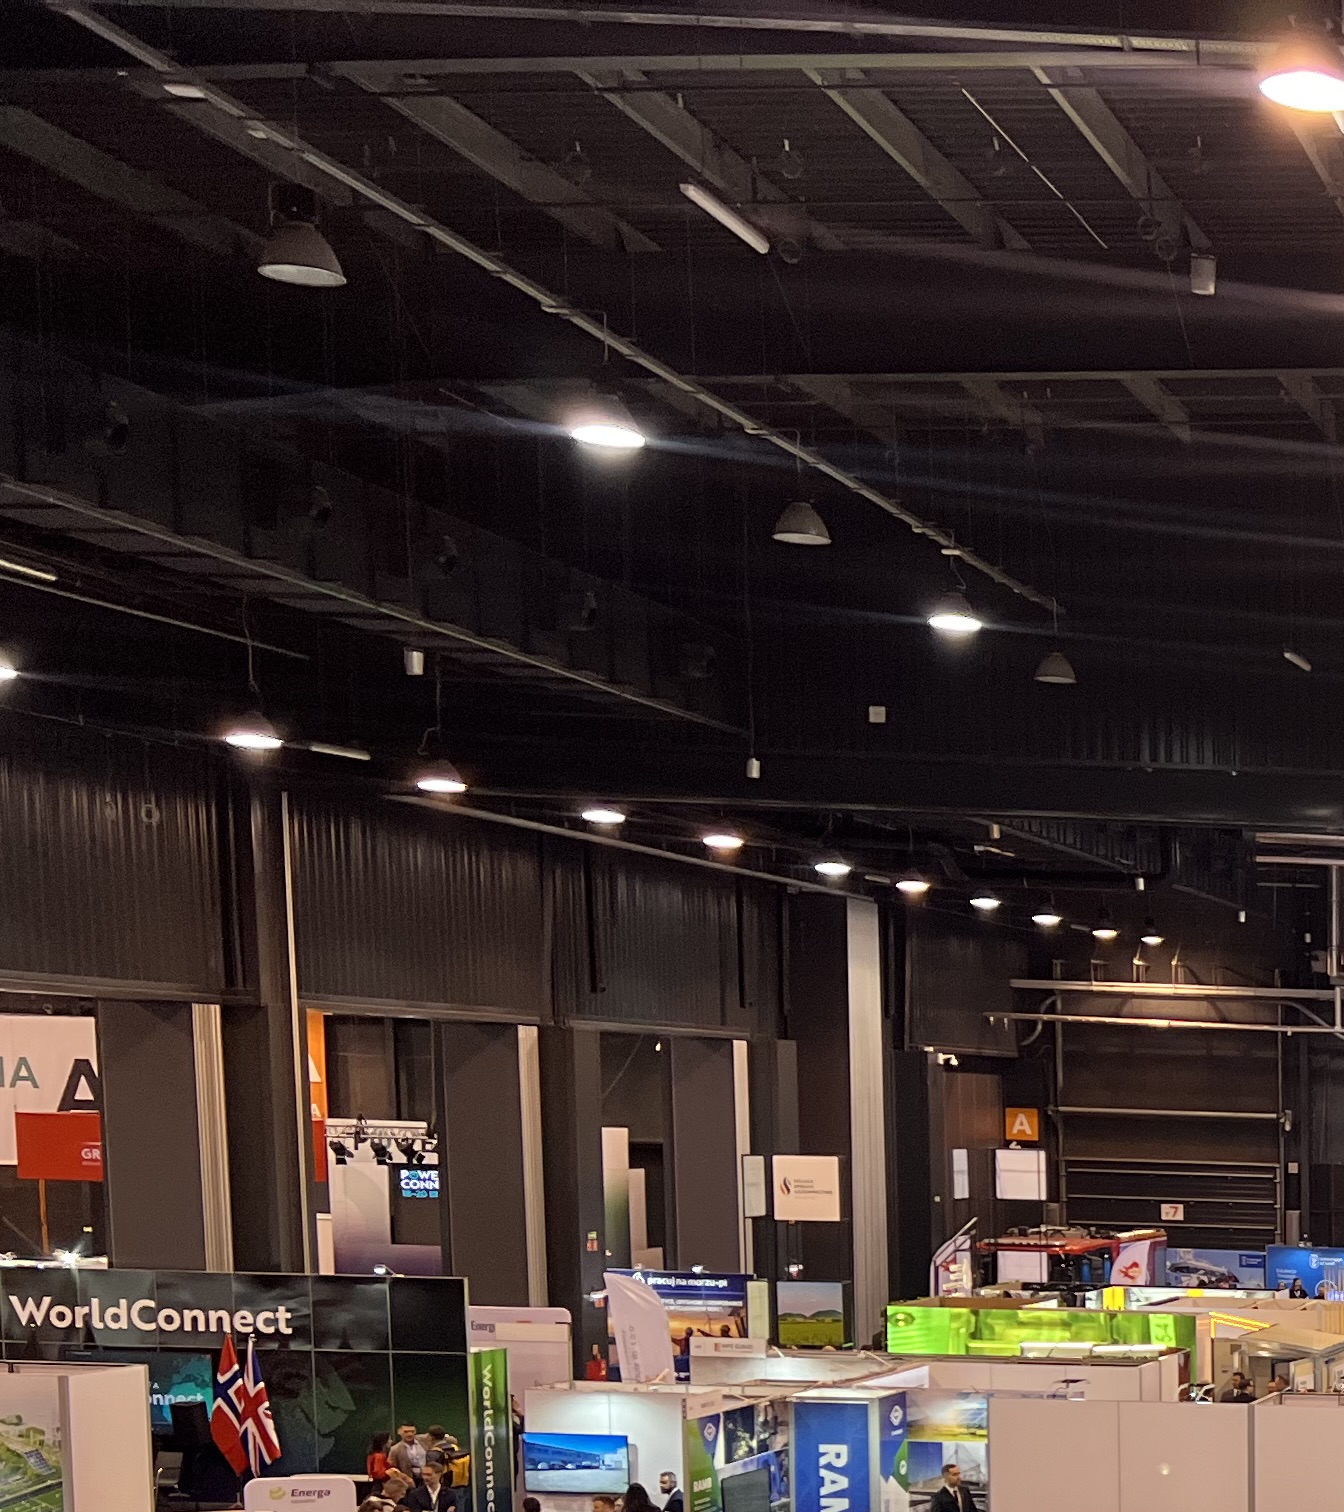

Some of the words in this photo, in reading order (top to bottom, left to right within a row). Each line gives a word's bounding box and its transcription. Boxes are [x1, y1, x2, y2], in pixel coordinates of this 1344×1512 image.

[1012, 1113, 1032, 1135] A
[9, 1295, 292, 1336] WorldConnect
[291, 1488, 331, 1498] Energa
